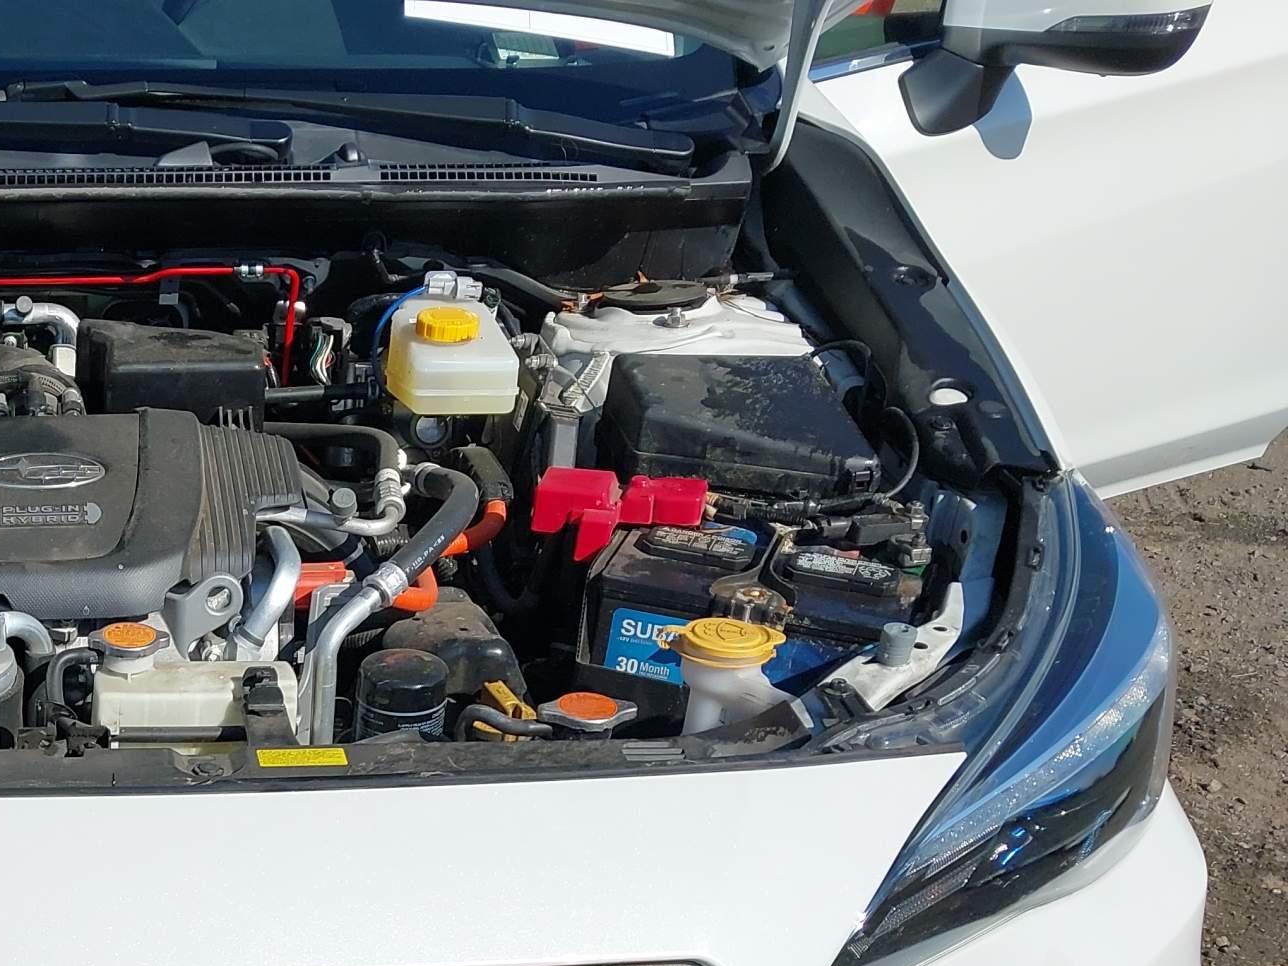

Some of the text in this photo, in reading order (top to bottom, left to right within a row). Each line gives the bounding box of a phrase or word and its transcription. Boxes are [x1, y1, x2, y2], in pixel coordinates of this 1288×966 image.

[2, 505, 80, 514] PLUG-IN
[2, 515, 80, 525] HYBRID
[615, 656, 638, 674] 30
[639, 661, 670, 676] Month
